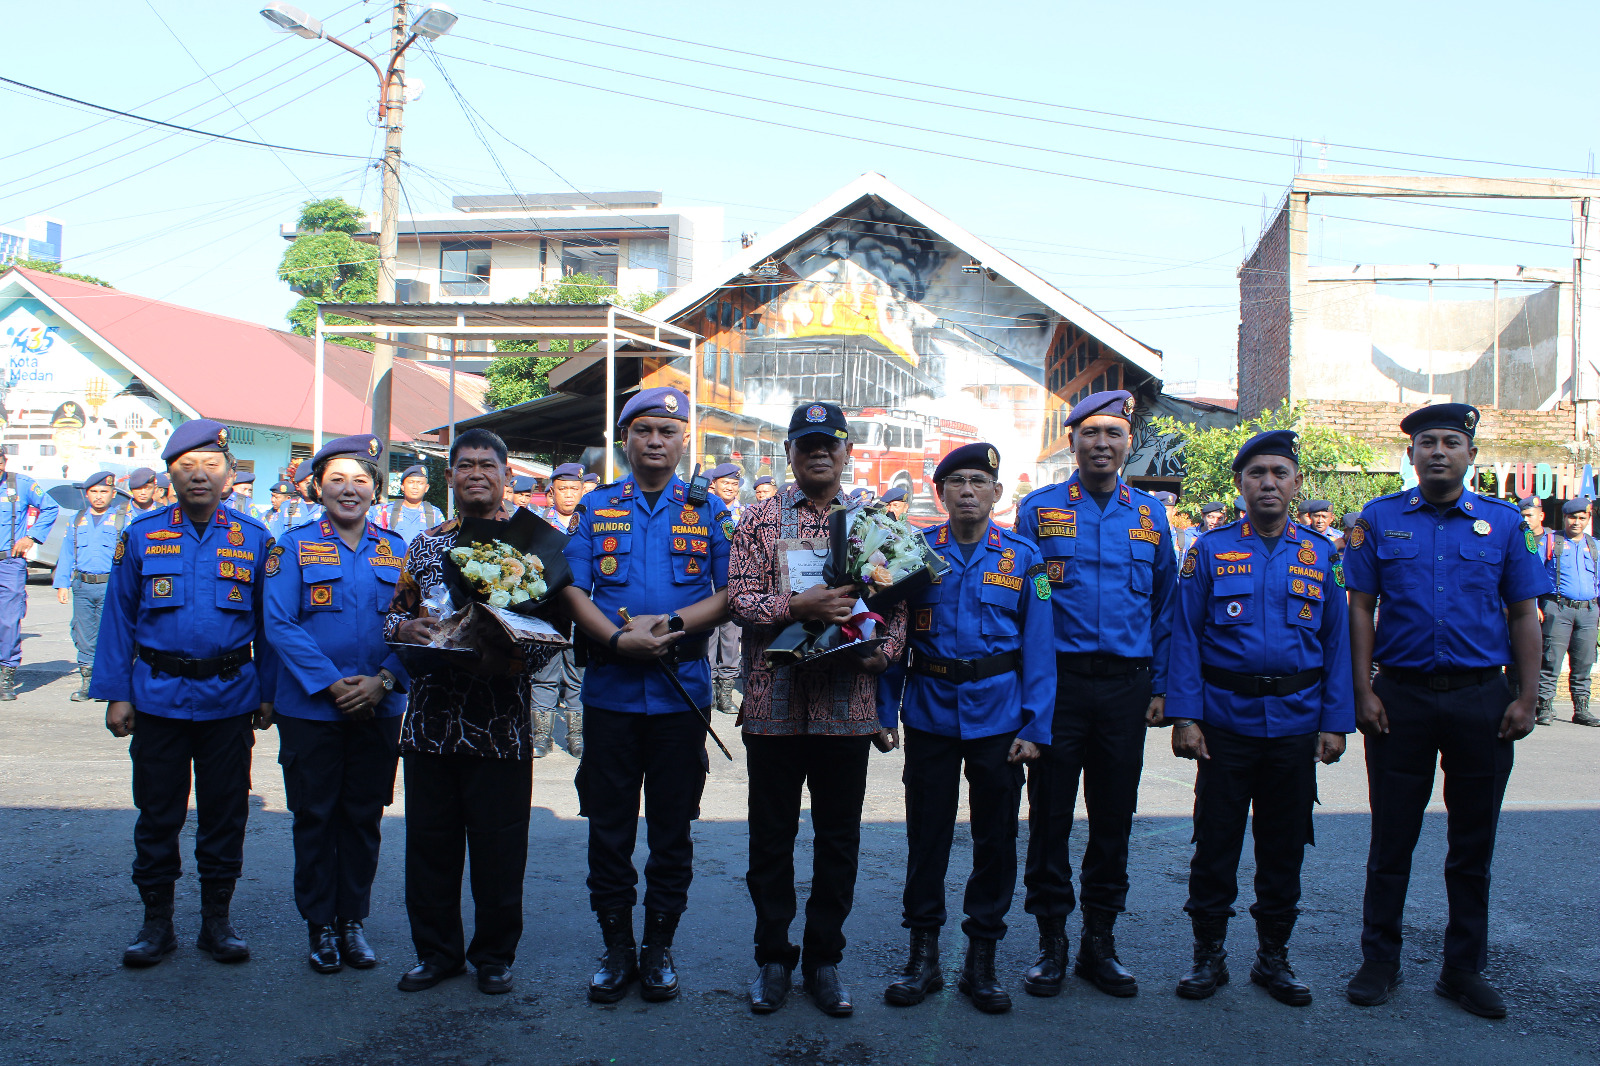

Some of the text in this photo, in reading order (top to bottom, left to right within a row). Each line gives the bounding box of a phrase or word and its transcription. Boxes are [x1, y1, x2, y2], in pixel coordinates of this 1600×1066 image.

[10, 355, 38, 368] Kota
[10, 369, 53, 381] Medan
[1494, 462, 1597, 501] YUDHA
[593, 522, 631, 532] WANDRO
[672, 525, 708, 536] PEMADAM
[145, 544, 181, 555] ARDHANI
[216, 548, 254, 561] PEMADAM
[1217, 564, 1252, 575] DONI
[1289, 565, 1324, 582] PEMADAM
[986, 573, 1020, 589] PEMADAM
